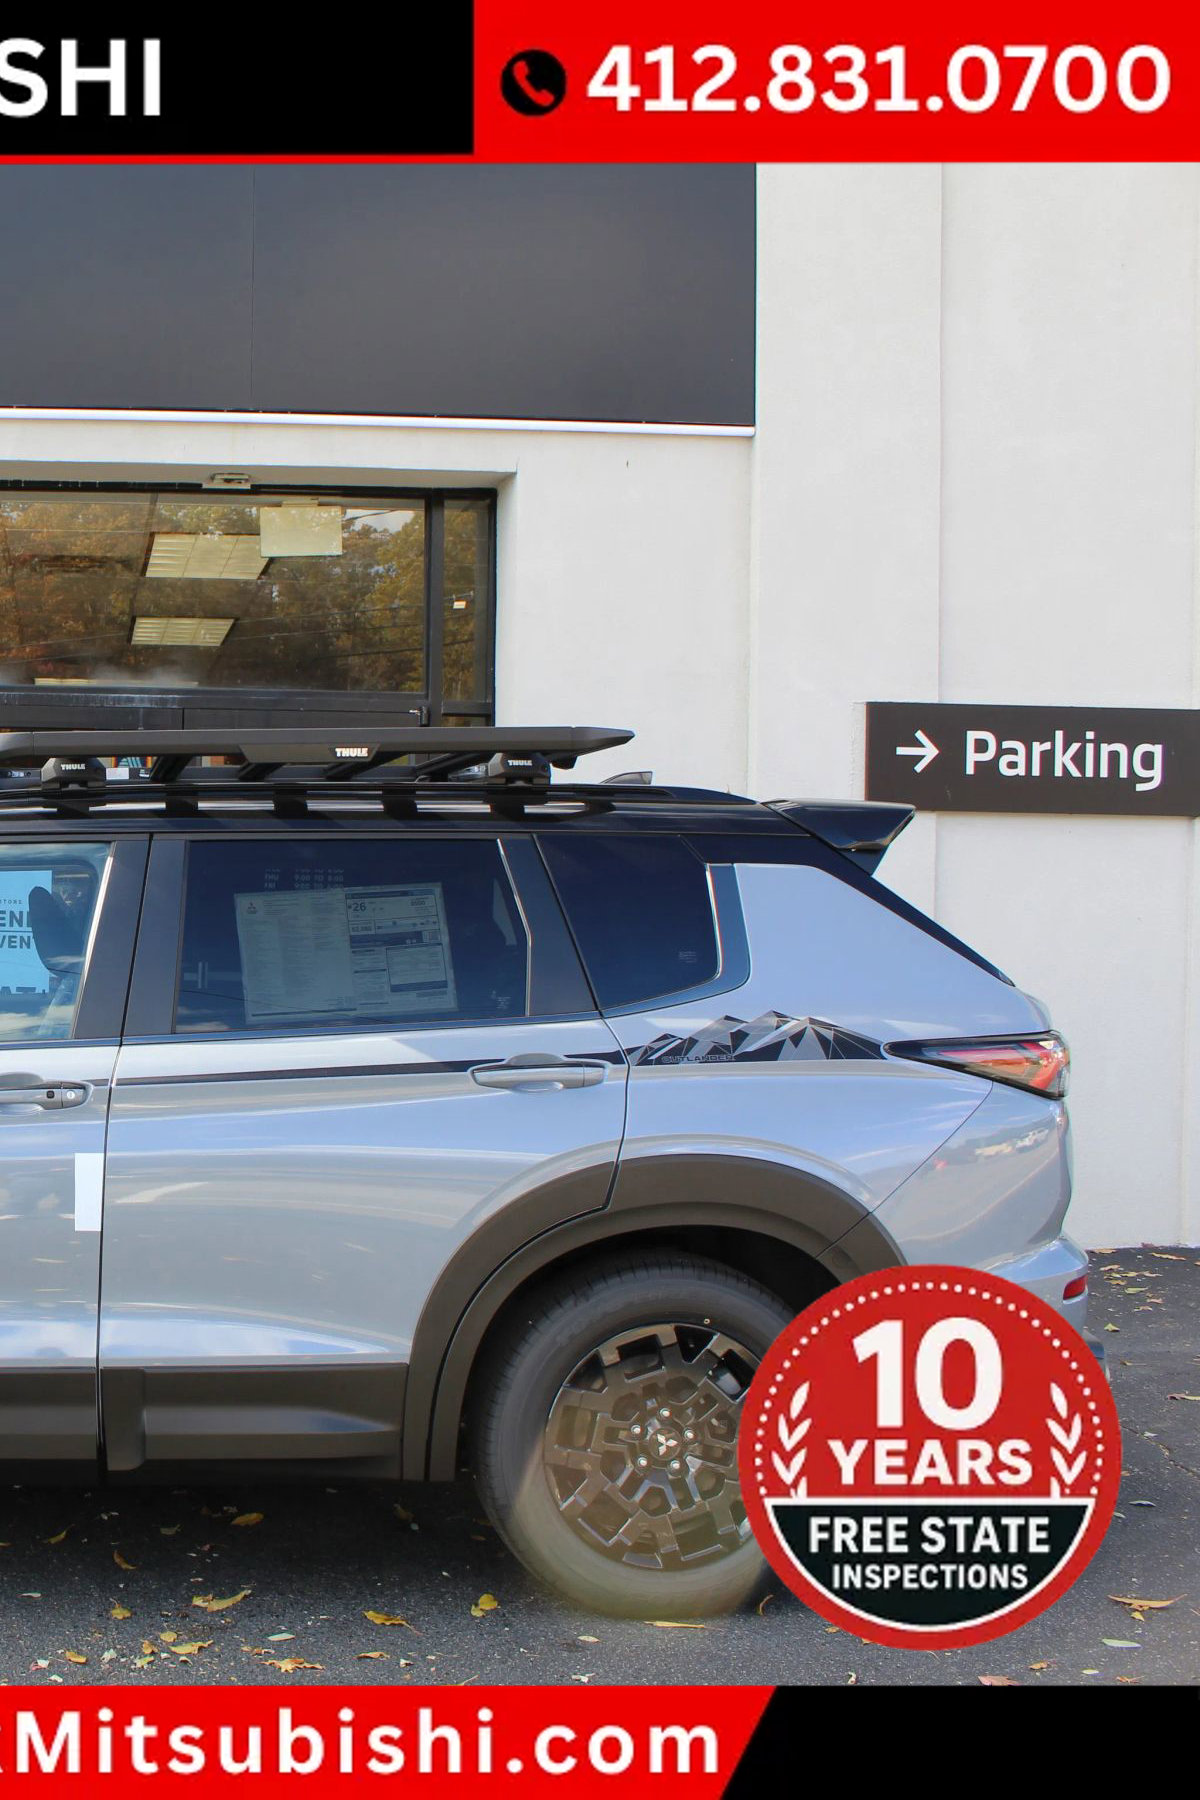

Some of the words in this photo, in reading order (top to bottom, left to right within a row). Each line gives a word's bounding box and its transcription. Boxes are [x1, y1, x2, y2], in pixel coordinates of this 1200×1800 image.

[334, 747, 368, 758] THULE
[507, 759, 533, 767] THULE
[965, 729, 1163, 792] Parking
[60, 763, 86, 771] THULE
[661, 1054, 733, 1064] OUTLANDER
